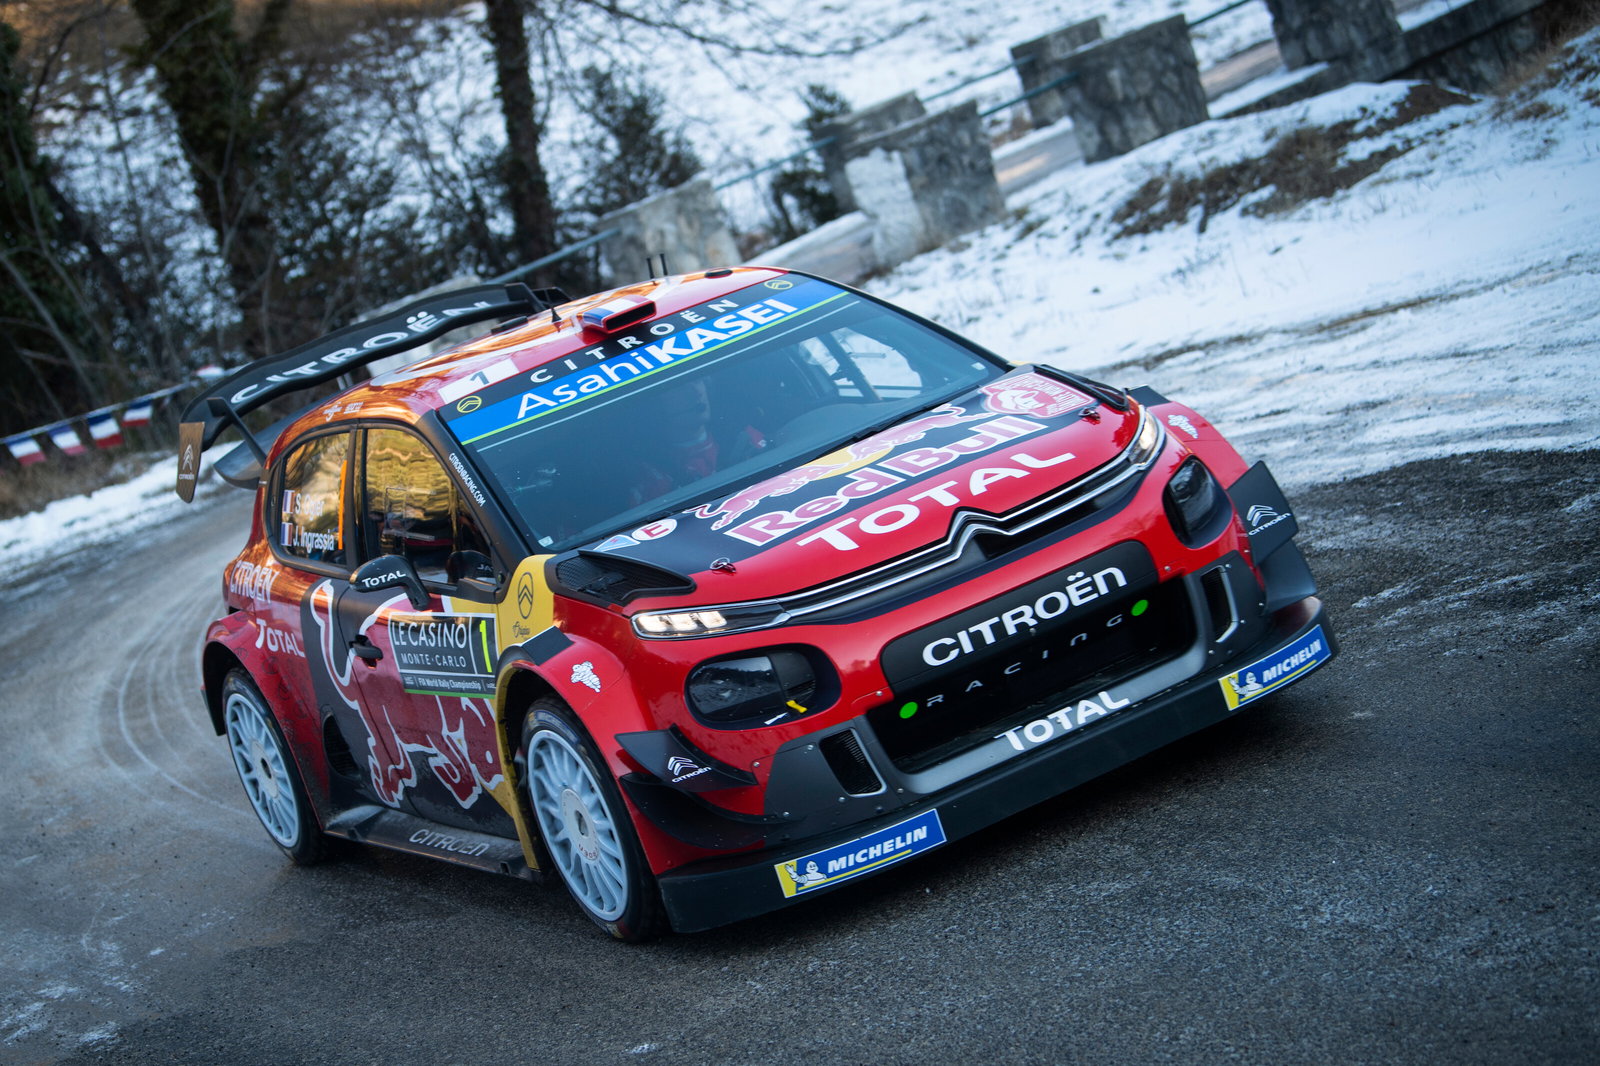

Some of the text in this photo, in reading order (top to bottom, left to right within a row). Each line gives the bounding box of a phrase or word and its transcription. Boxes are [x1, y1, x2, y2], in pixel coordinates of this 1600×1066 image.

[516, 298, 798, 420] AsahiKASEI
[529, 299, 739, 384] CITROËN
[470, 371, 490, 385] 1
[796, 452, 1077, 552] TOTAL
[293, 524, 335, 554] J. Ingrassia
[361, 570, 407, 588] TOTAL
[255, 617, 306, 658] TOTAL
[391, 621, 467, 649] LE CASINO
[479, 620, 492, 673] 1
[418, 677, 426, 687] FIA
[425, 678, 439, 688] World
[439, 679, 450, 690] Rally
[450, 679, 482, 691] Championship
[1262, 638, 1323, 684] MICHELIN
[993, 691, 1131, 751] TOTAL
[827, 825, 928, 874] MICHELIN
